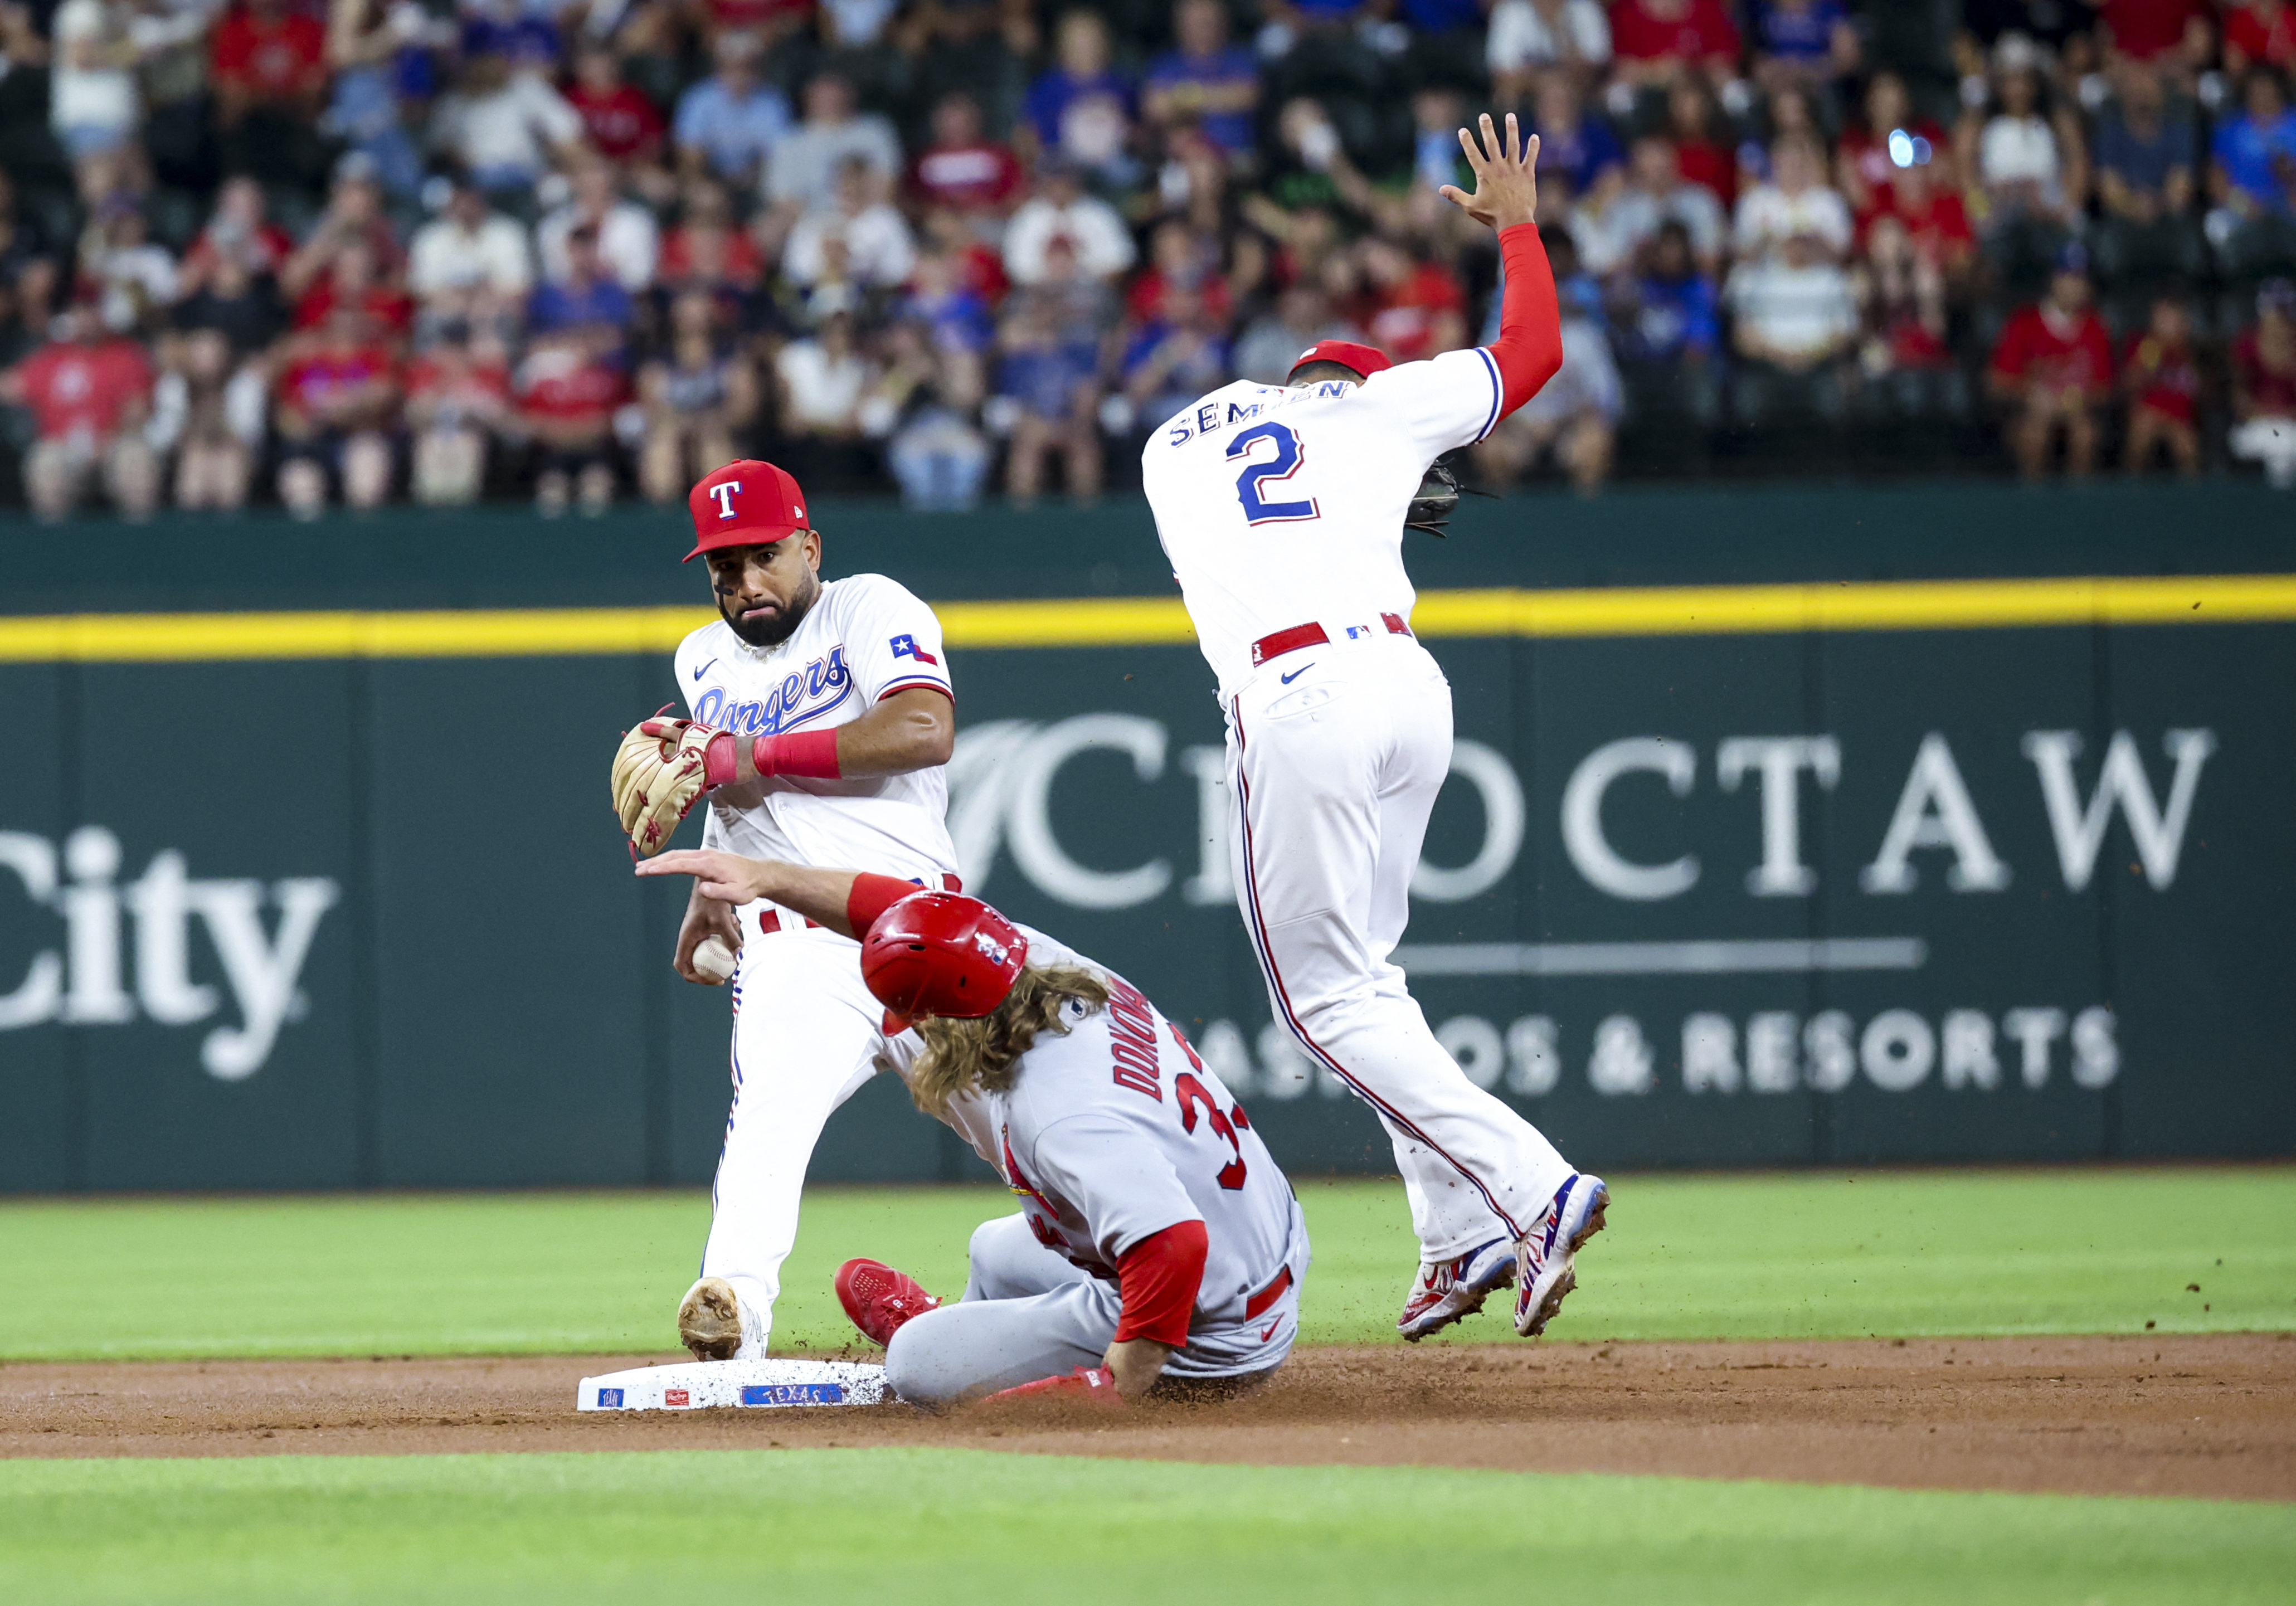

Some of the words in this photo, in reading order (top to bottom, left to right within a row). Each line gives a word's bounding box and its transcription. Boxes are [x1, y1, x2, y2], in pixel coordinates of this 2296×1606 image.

[1169, 381, 1351, 448] SEMEN
[709, 480, 742, 520] T
[1225, 421, 1321, 527] 2
[694, 643, 855, 738] Rangers
[1586, 1013, 1655, 1096] &
[1680, 1005, 2122, 1093] RESORTS
